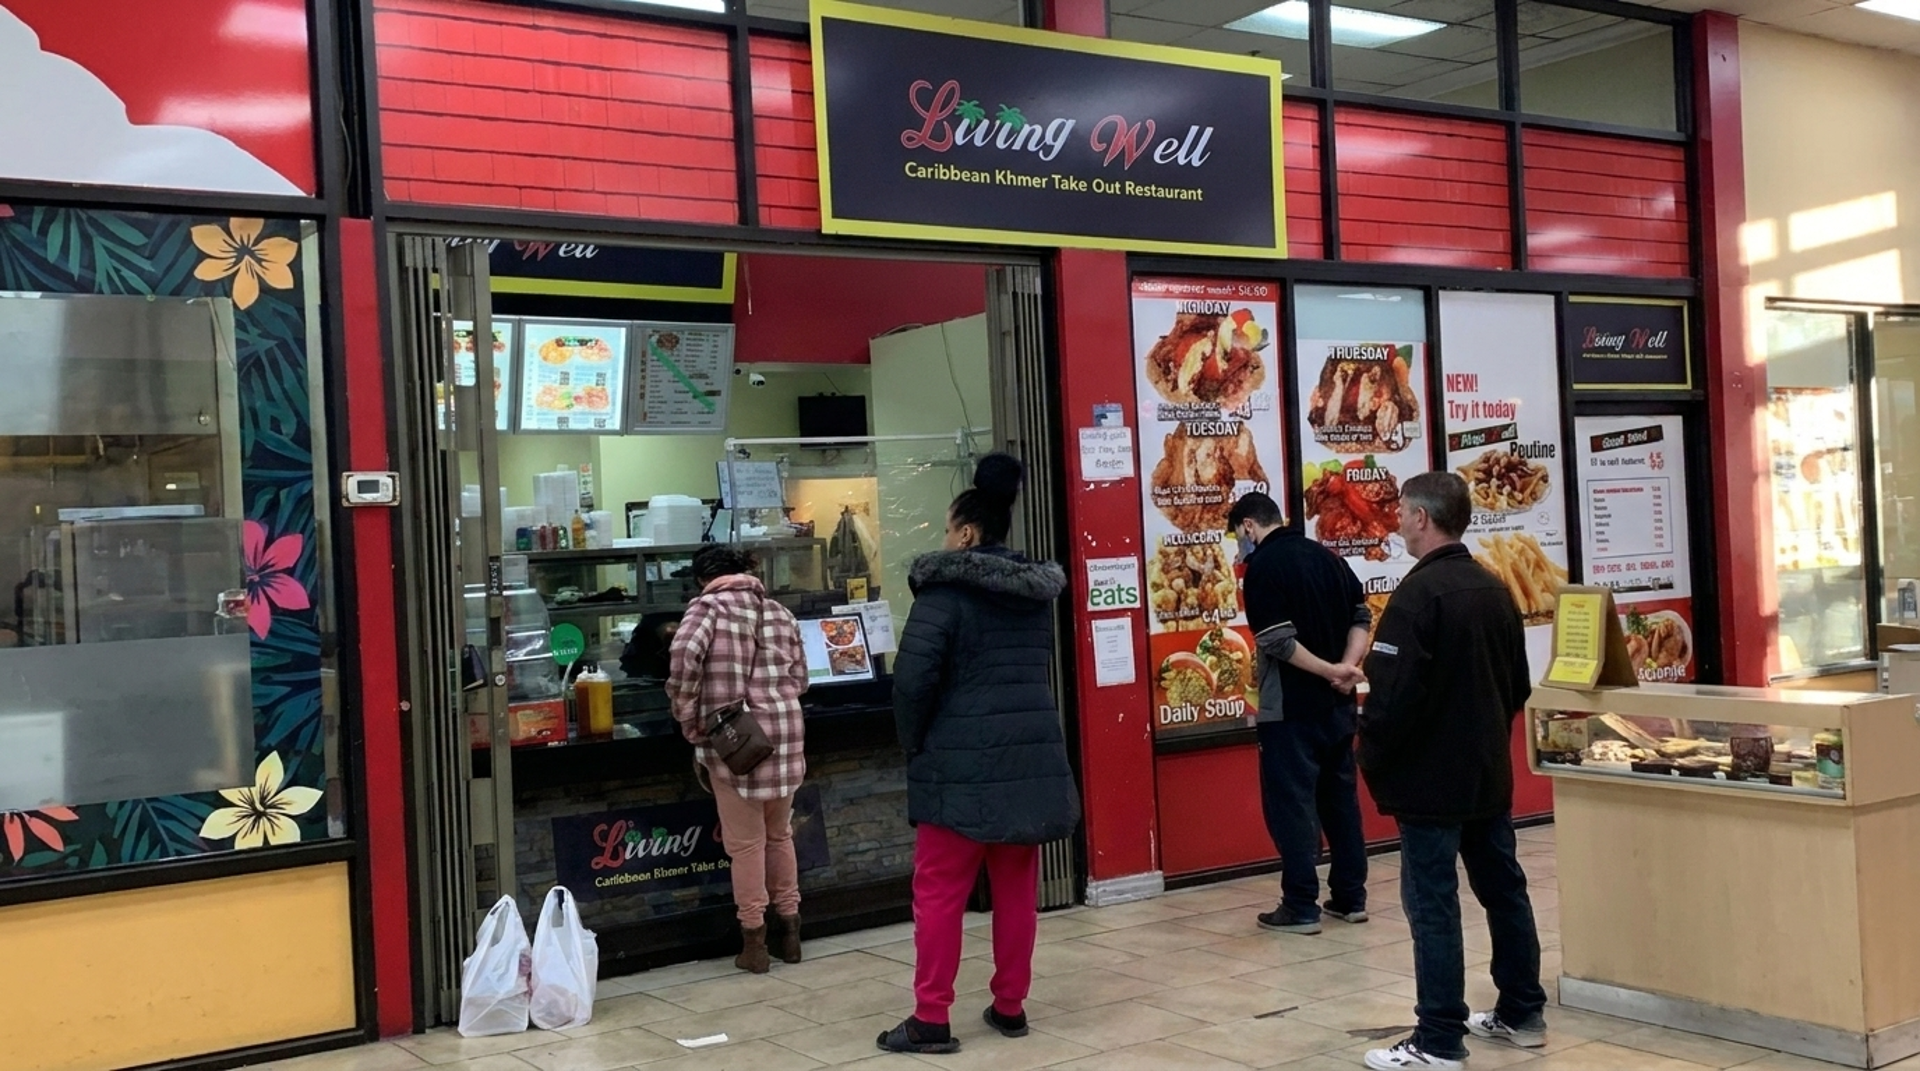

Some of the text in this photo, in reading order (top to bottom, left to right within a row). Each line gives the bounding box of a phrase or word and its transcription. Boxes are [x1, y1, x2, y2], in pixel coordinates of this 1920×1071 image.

[901, 80, 1214, 170] Living Well
[905, 162, 1203, 201] Caribbean Khmer Take Out Restaurant
[1446, 373, 1478, 392] NEW!
[1448, 399, 1516, 422] Try it today
[1510, 440, 1555, 459] Poutine
[1090, 584, 1138, 606] eats
[1159, 699, 1245, 724] Daily Soup
[591, 819, 703, 870] Living
